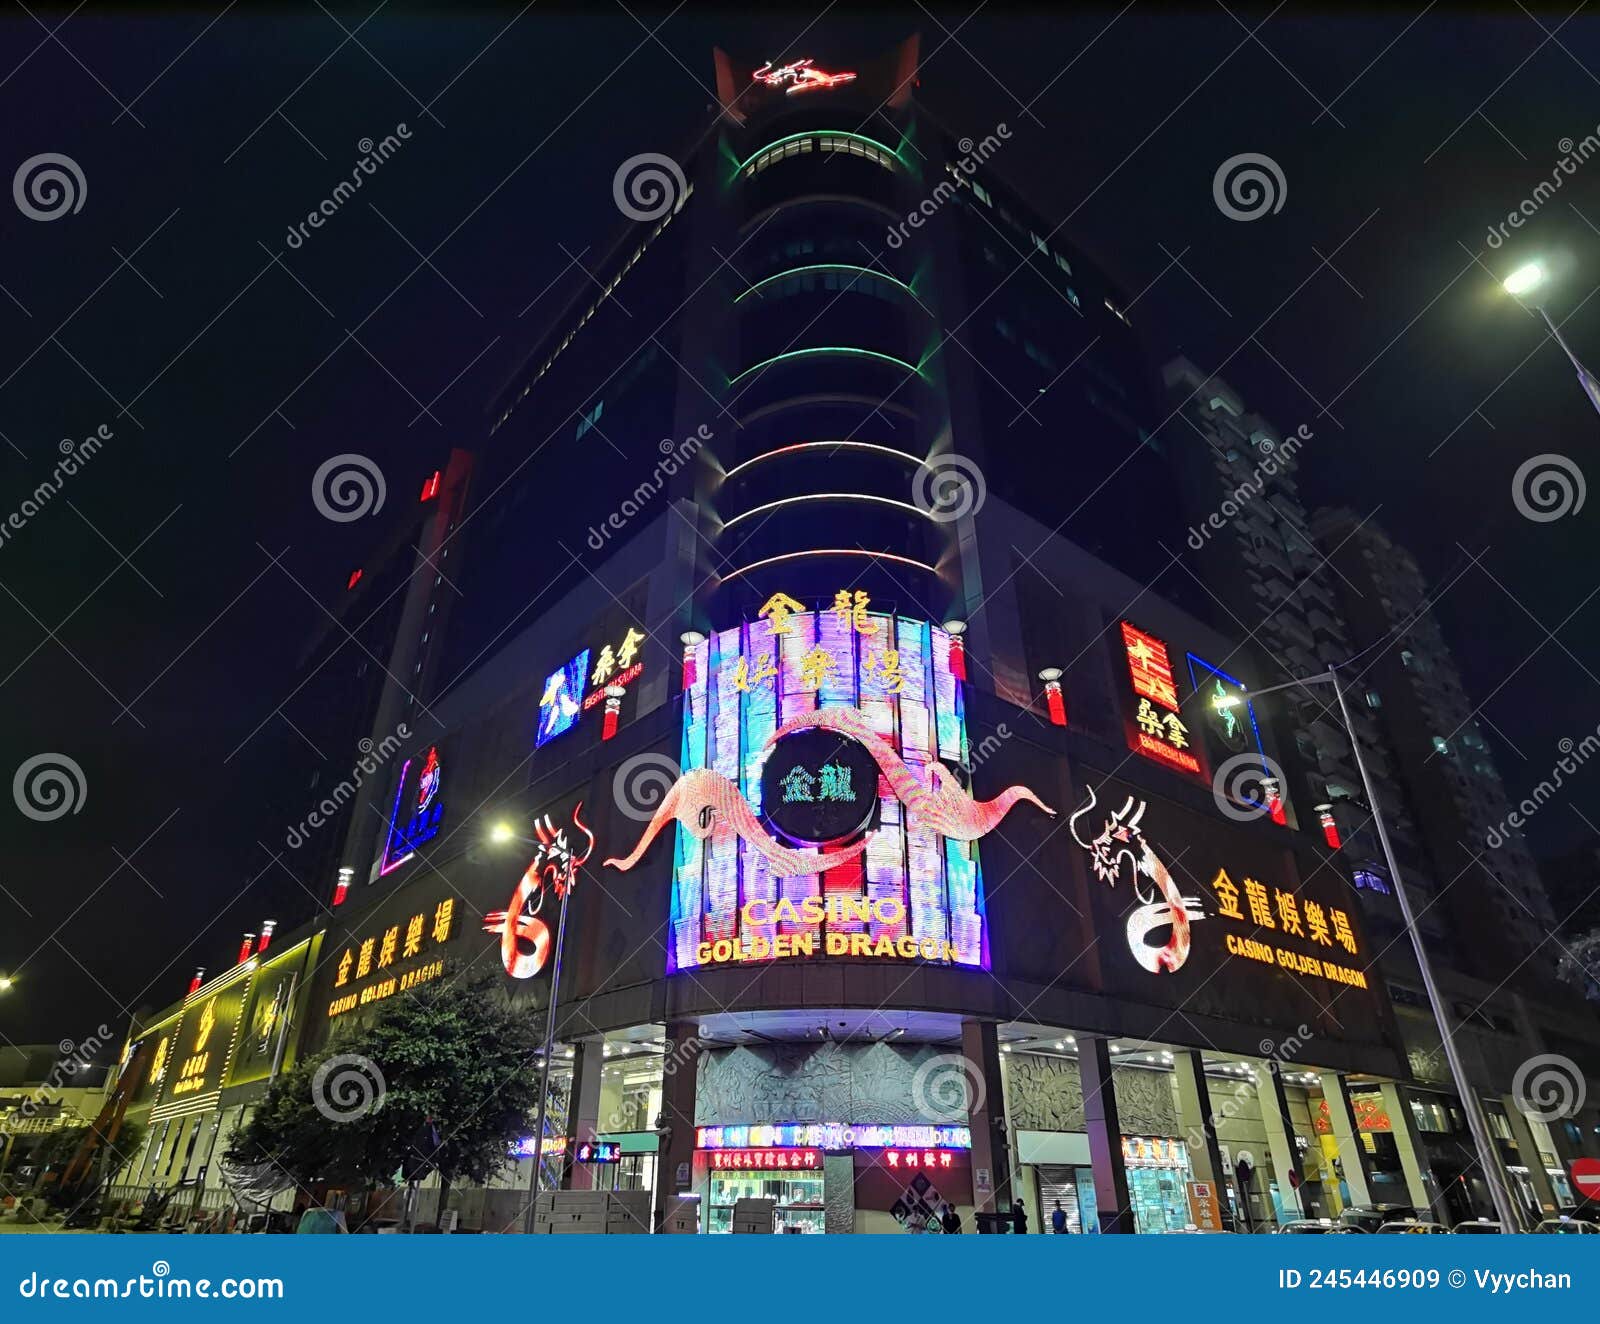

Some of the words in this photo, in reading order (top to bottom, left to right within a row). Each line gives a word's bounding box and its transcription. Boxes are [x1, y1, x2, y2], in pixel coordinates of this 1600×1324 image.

[758, 590, 880, 636] 金龍
[741, 895, 906, 926] CASINO
[695, 932, 814, 965] GOLDEN
[825, 932, 959, 962] DRAGON
[1226, 934, 1275, 964] CASINO
[1276, 948, 1323, 977] GOLDEN
[1323, 961, 1368, 989] DRAGON
[328, 993, 358, 1017] CASINO
[360, 977, 397, 1005] GOLDEN
[400, 959, 444, 991] DRAGON
